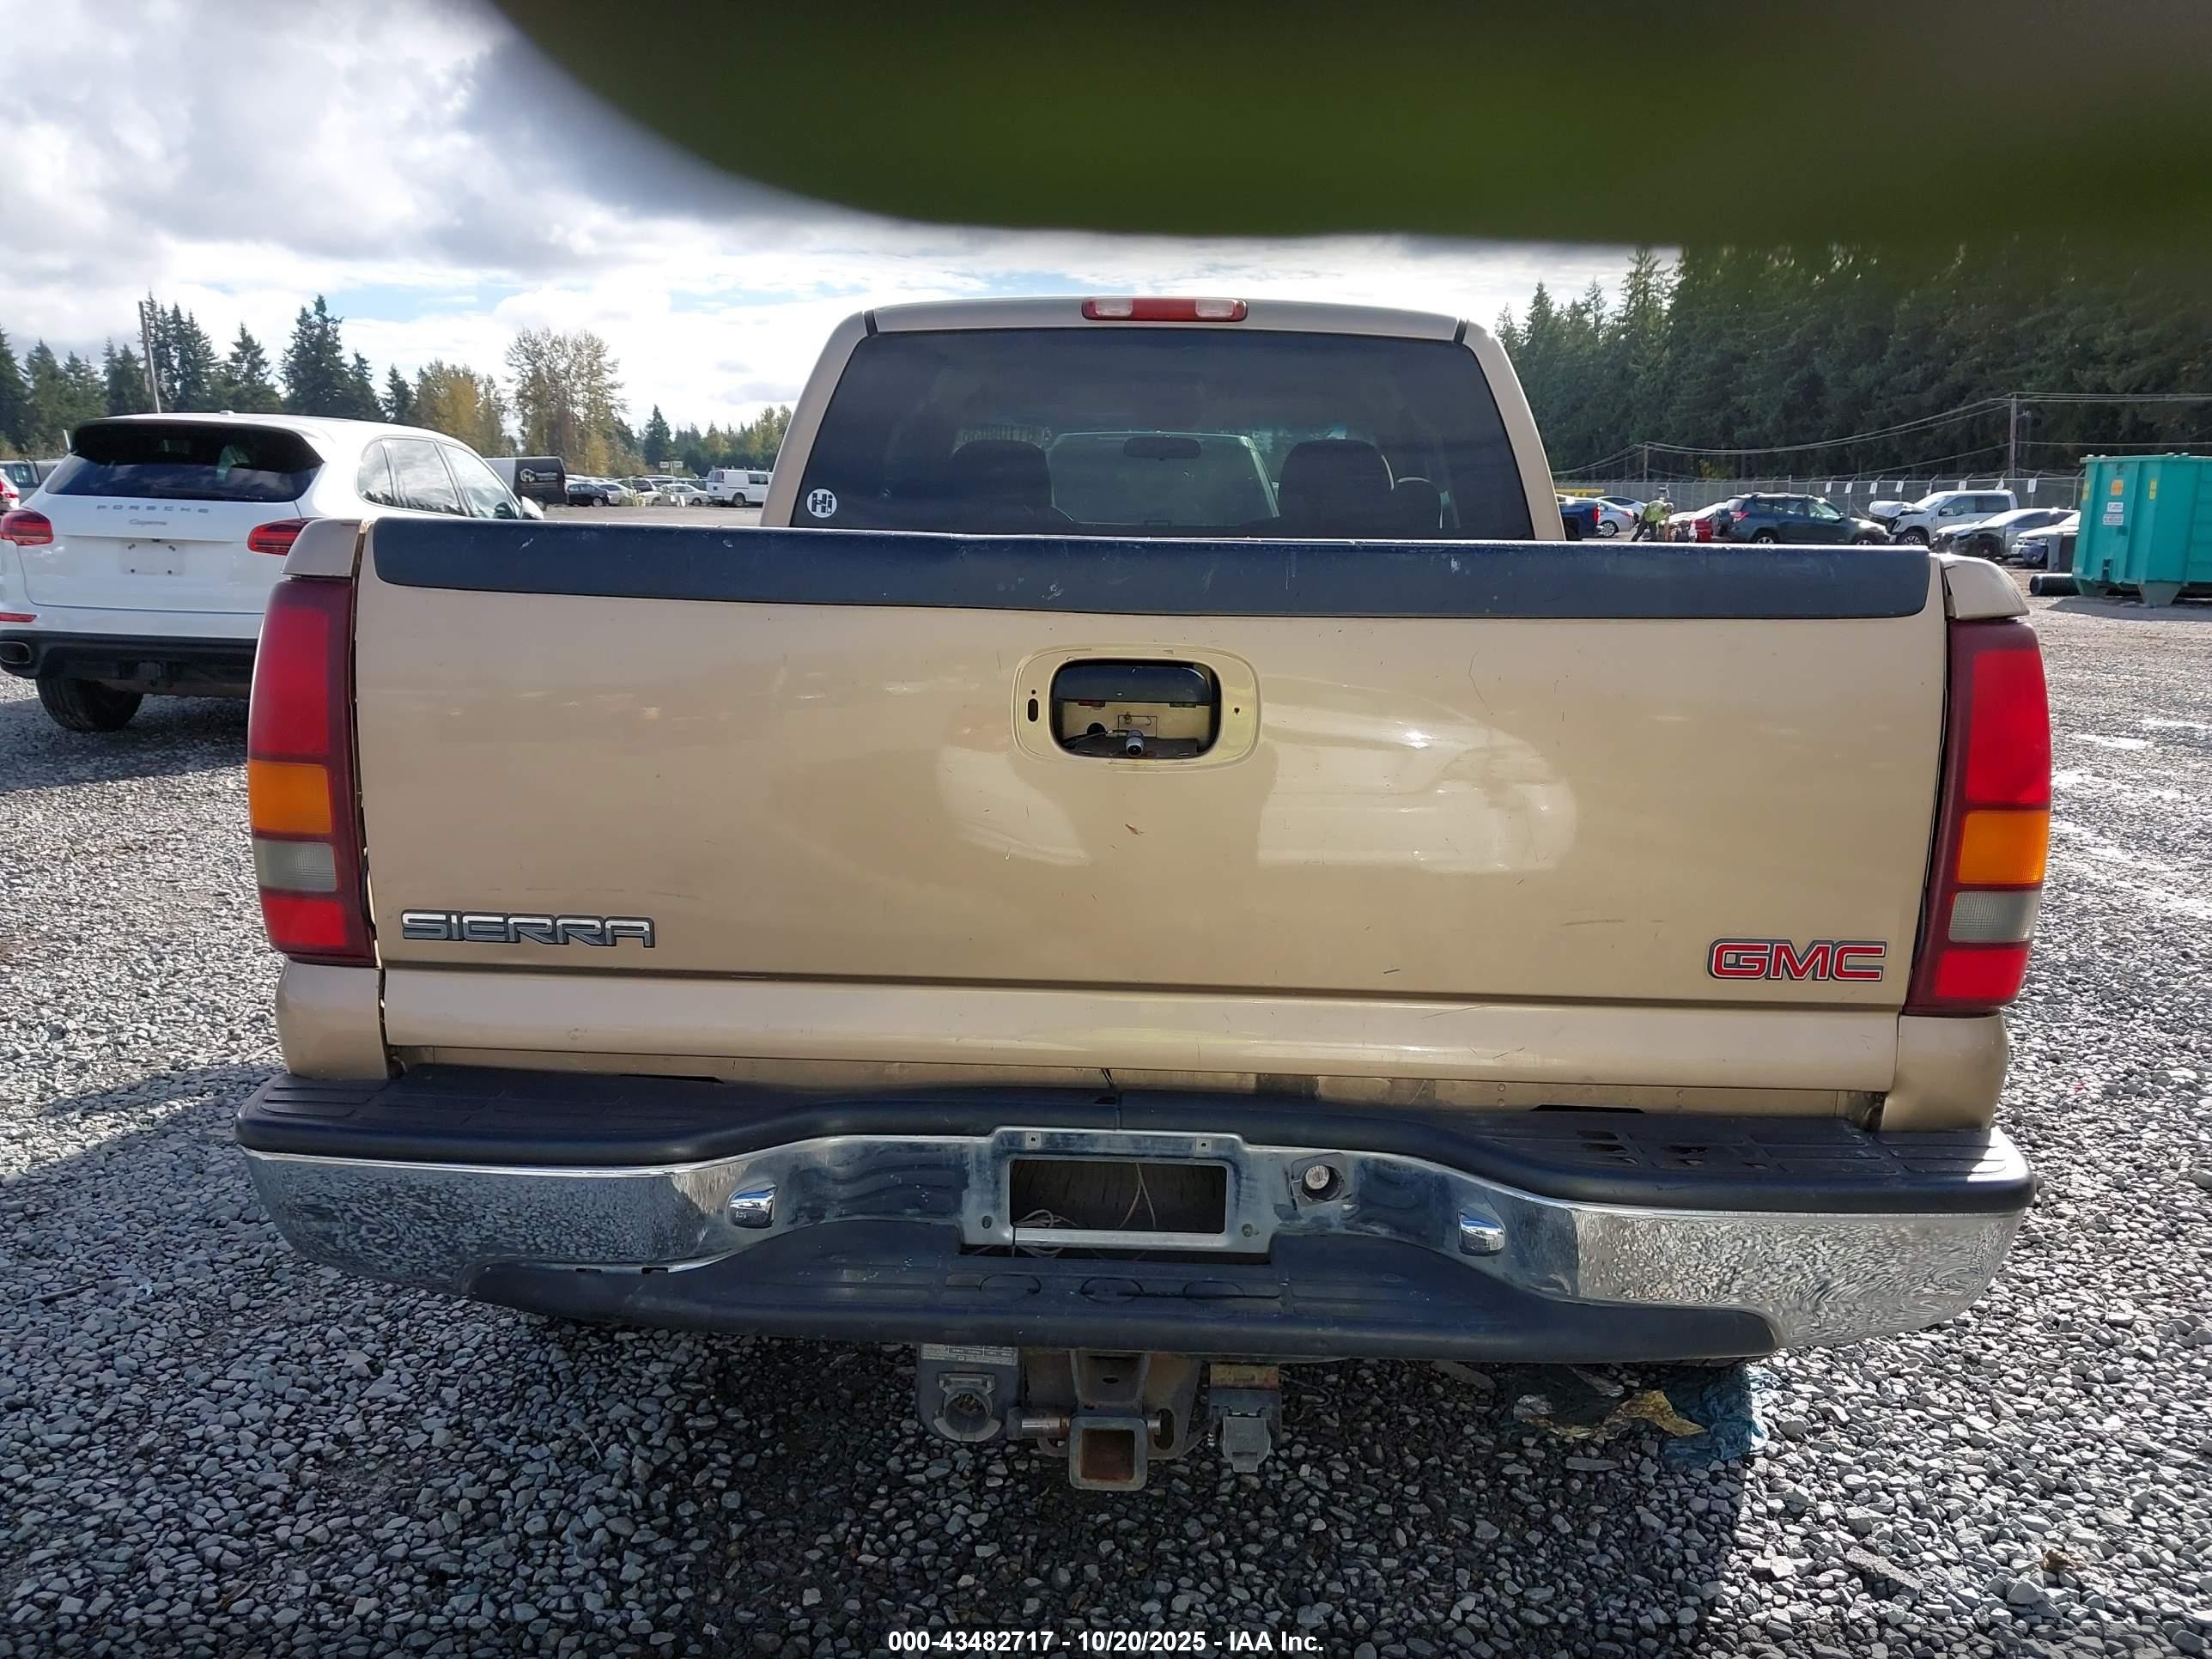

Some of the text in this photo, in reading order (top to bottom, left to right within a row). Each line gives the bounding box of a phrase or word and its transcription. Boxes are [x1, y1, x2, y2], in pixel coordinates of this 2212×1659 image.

[96, 504, 209, 514] PORSCHE
[402, 909, 655, 948] SIERRA
[1708, 939, 1887, 981] GMC
